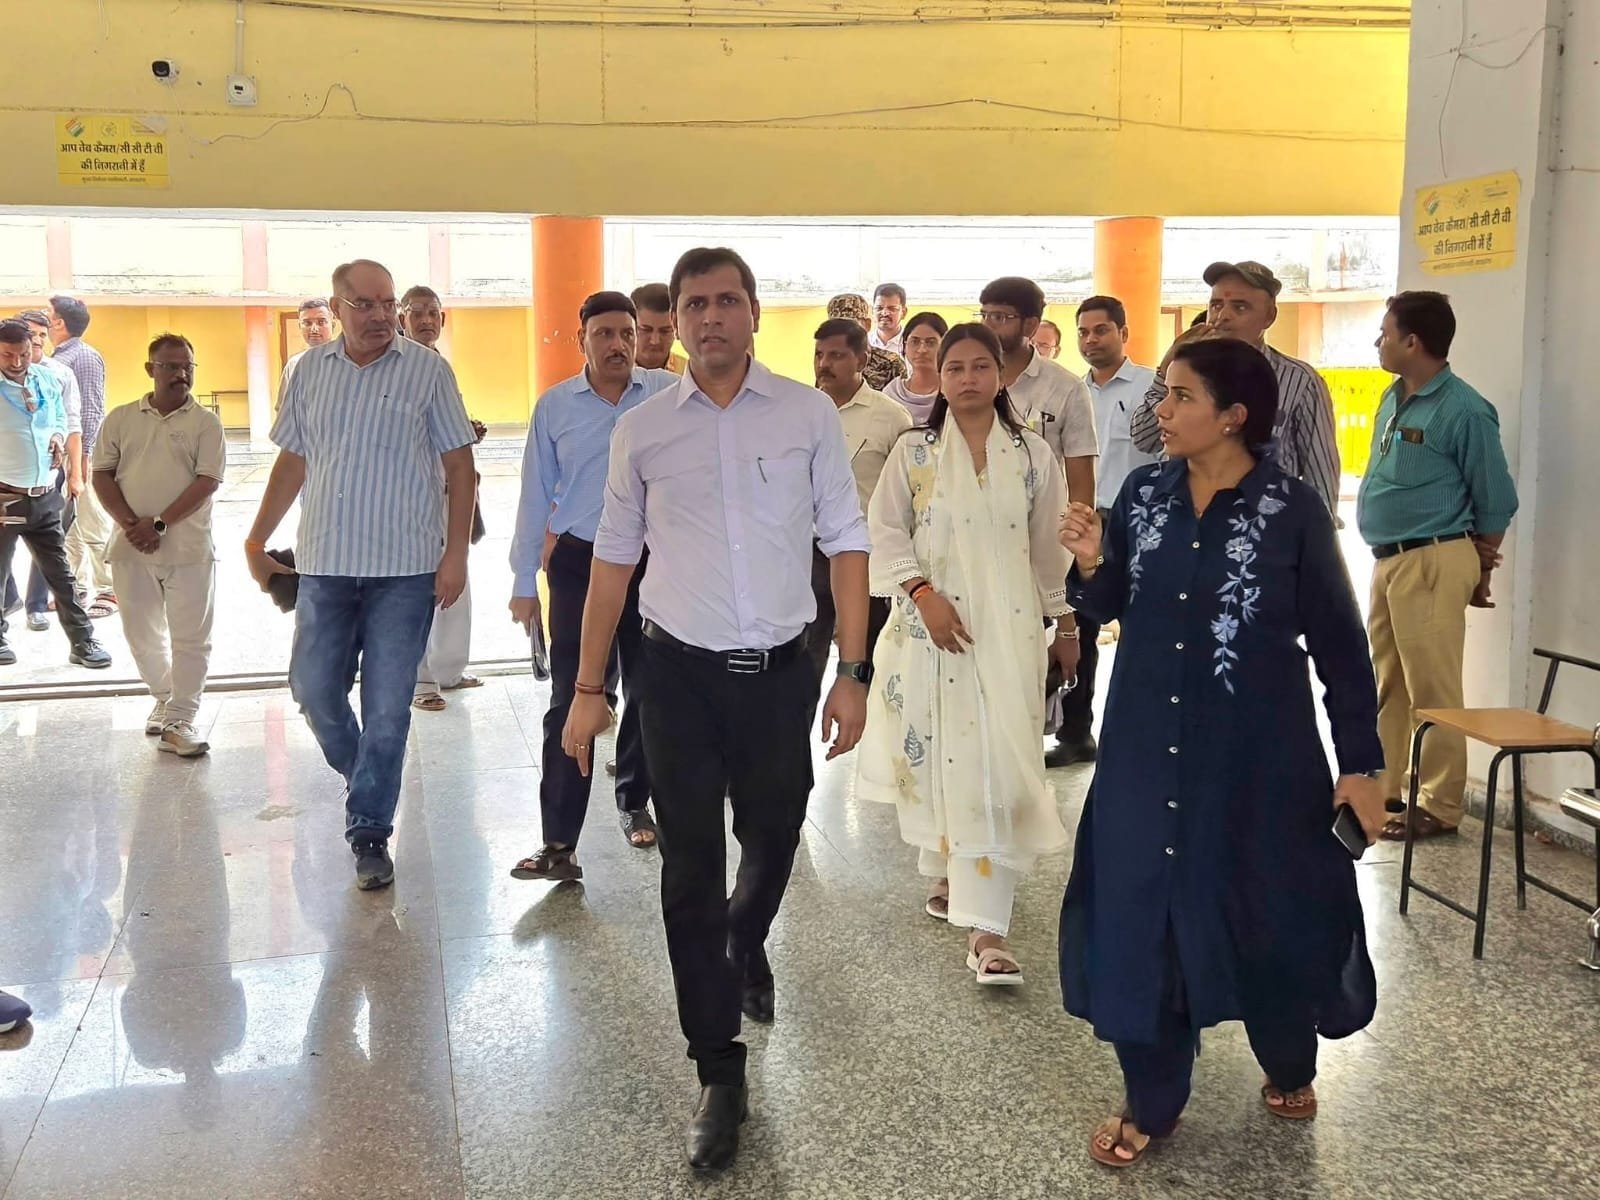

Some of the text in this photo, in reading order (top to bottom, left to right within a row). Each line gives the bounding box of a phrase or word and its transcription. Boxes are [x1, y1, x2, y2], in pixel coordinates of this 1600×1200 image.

[61, 143, 77, 153] आप
[132, 142, 142, 154] सी
[144, 142, 152, 154] टी
[154, 142, 163, 154] वी
[81, 158, 93, 171] की
[94, 159, 129, 171] निगरानी
[130, 159, 138, 171] में
[1418, 224, 1432, 236] आप
[1480, 210, 1490, 226] सी
[1491, 208, 1500, 225] टी
[1501, 206, 1512, 223] वी
[1433, 240, 1444, 256] की
[1445, 235, 1477, 255] निगरानी
